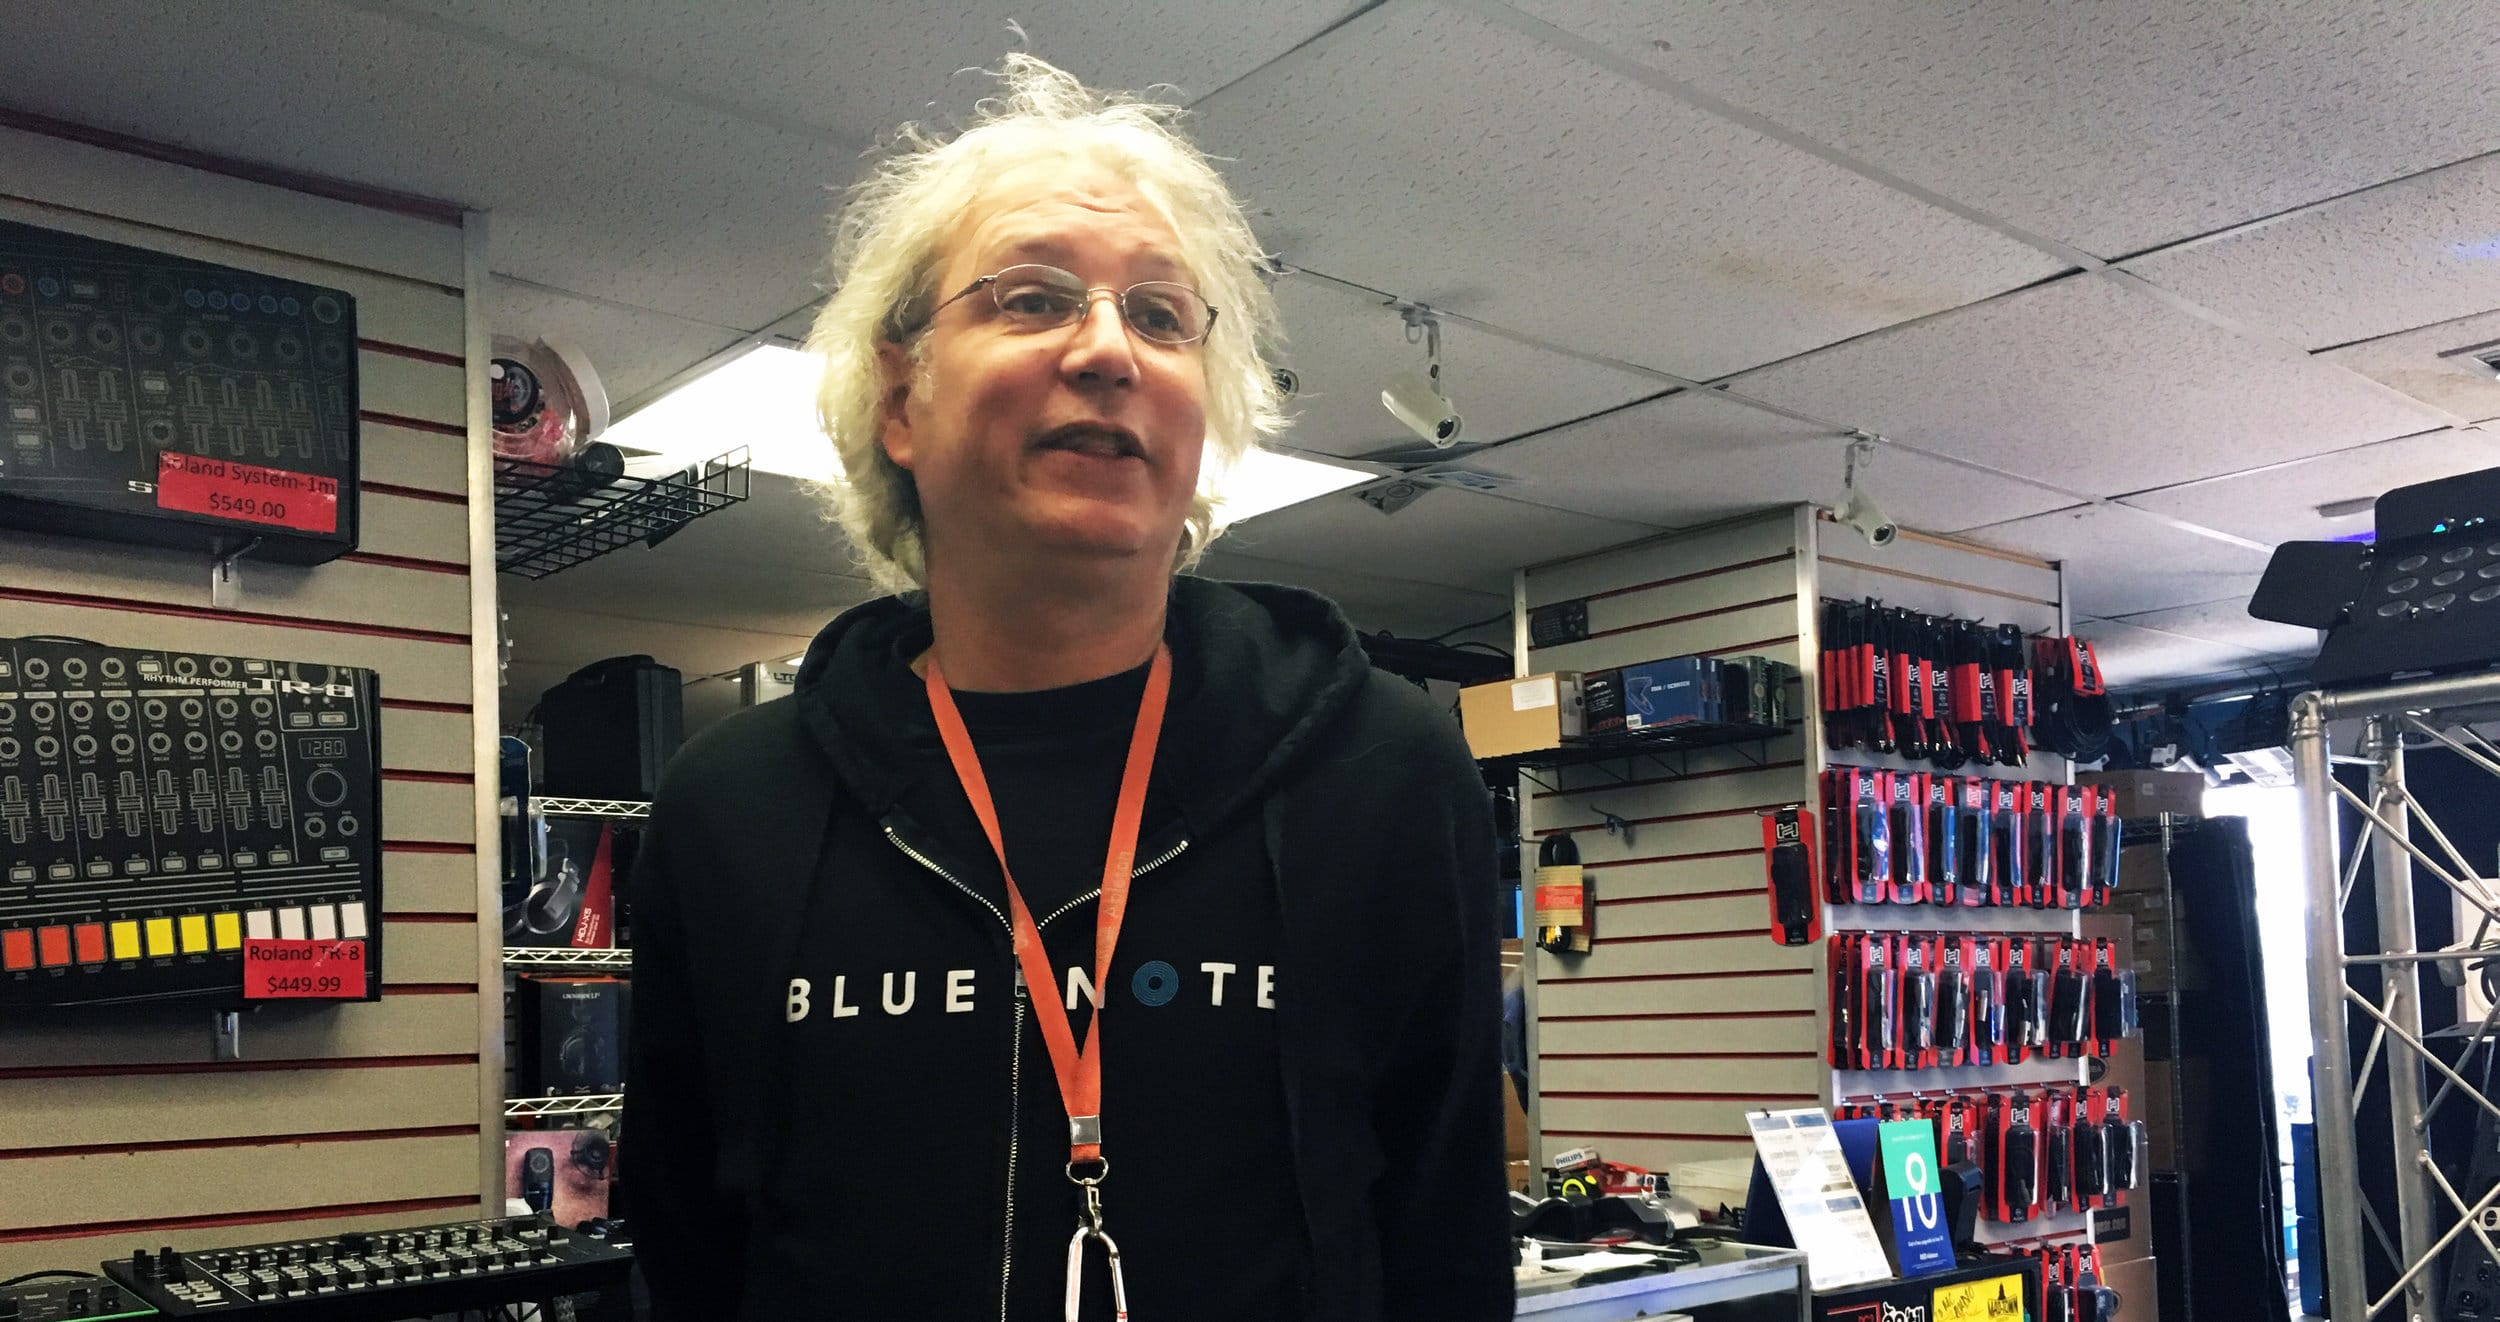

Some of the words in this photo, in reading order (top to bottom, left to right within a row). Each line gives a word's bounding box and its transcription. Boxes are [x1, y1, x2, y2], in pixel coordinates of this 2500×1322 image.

[231, 466, 335, 494] System-1m
[209, 492, 286, 519] $549.00
[143, 674, 187, 685] RHYTHM
[190, 677, 248, 689] PERFORMER
[252, 677, 354, 698] TR-8
[250, 945, 312, 961] Roland
[318, 945, 359, 961] TR-8
[268, 975, 341, 994] $449.99
[786, 969, 976, 1023] BLUE
[1556, 1152, 1583, 1165] PHILIPS
[1905, 1152, 1927, 1195] 9
[1902, 1192, 1938, 1232] 10
